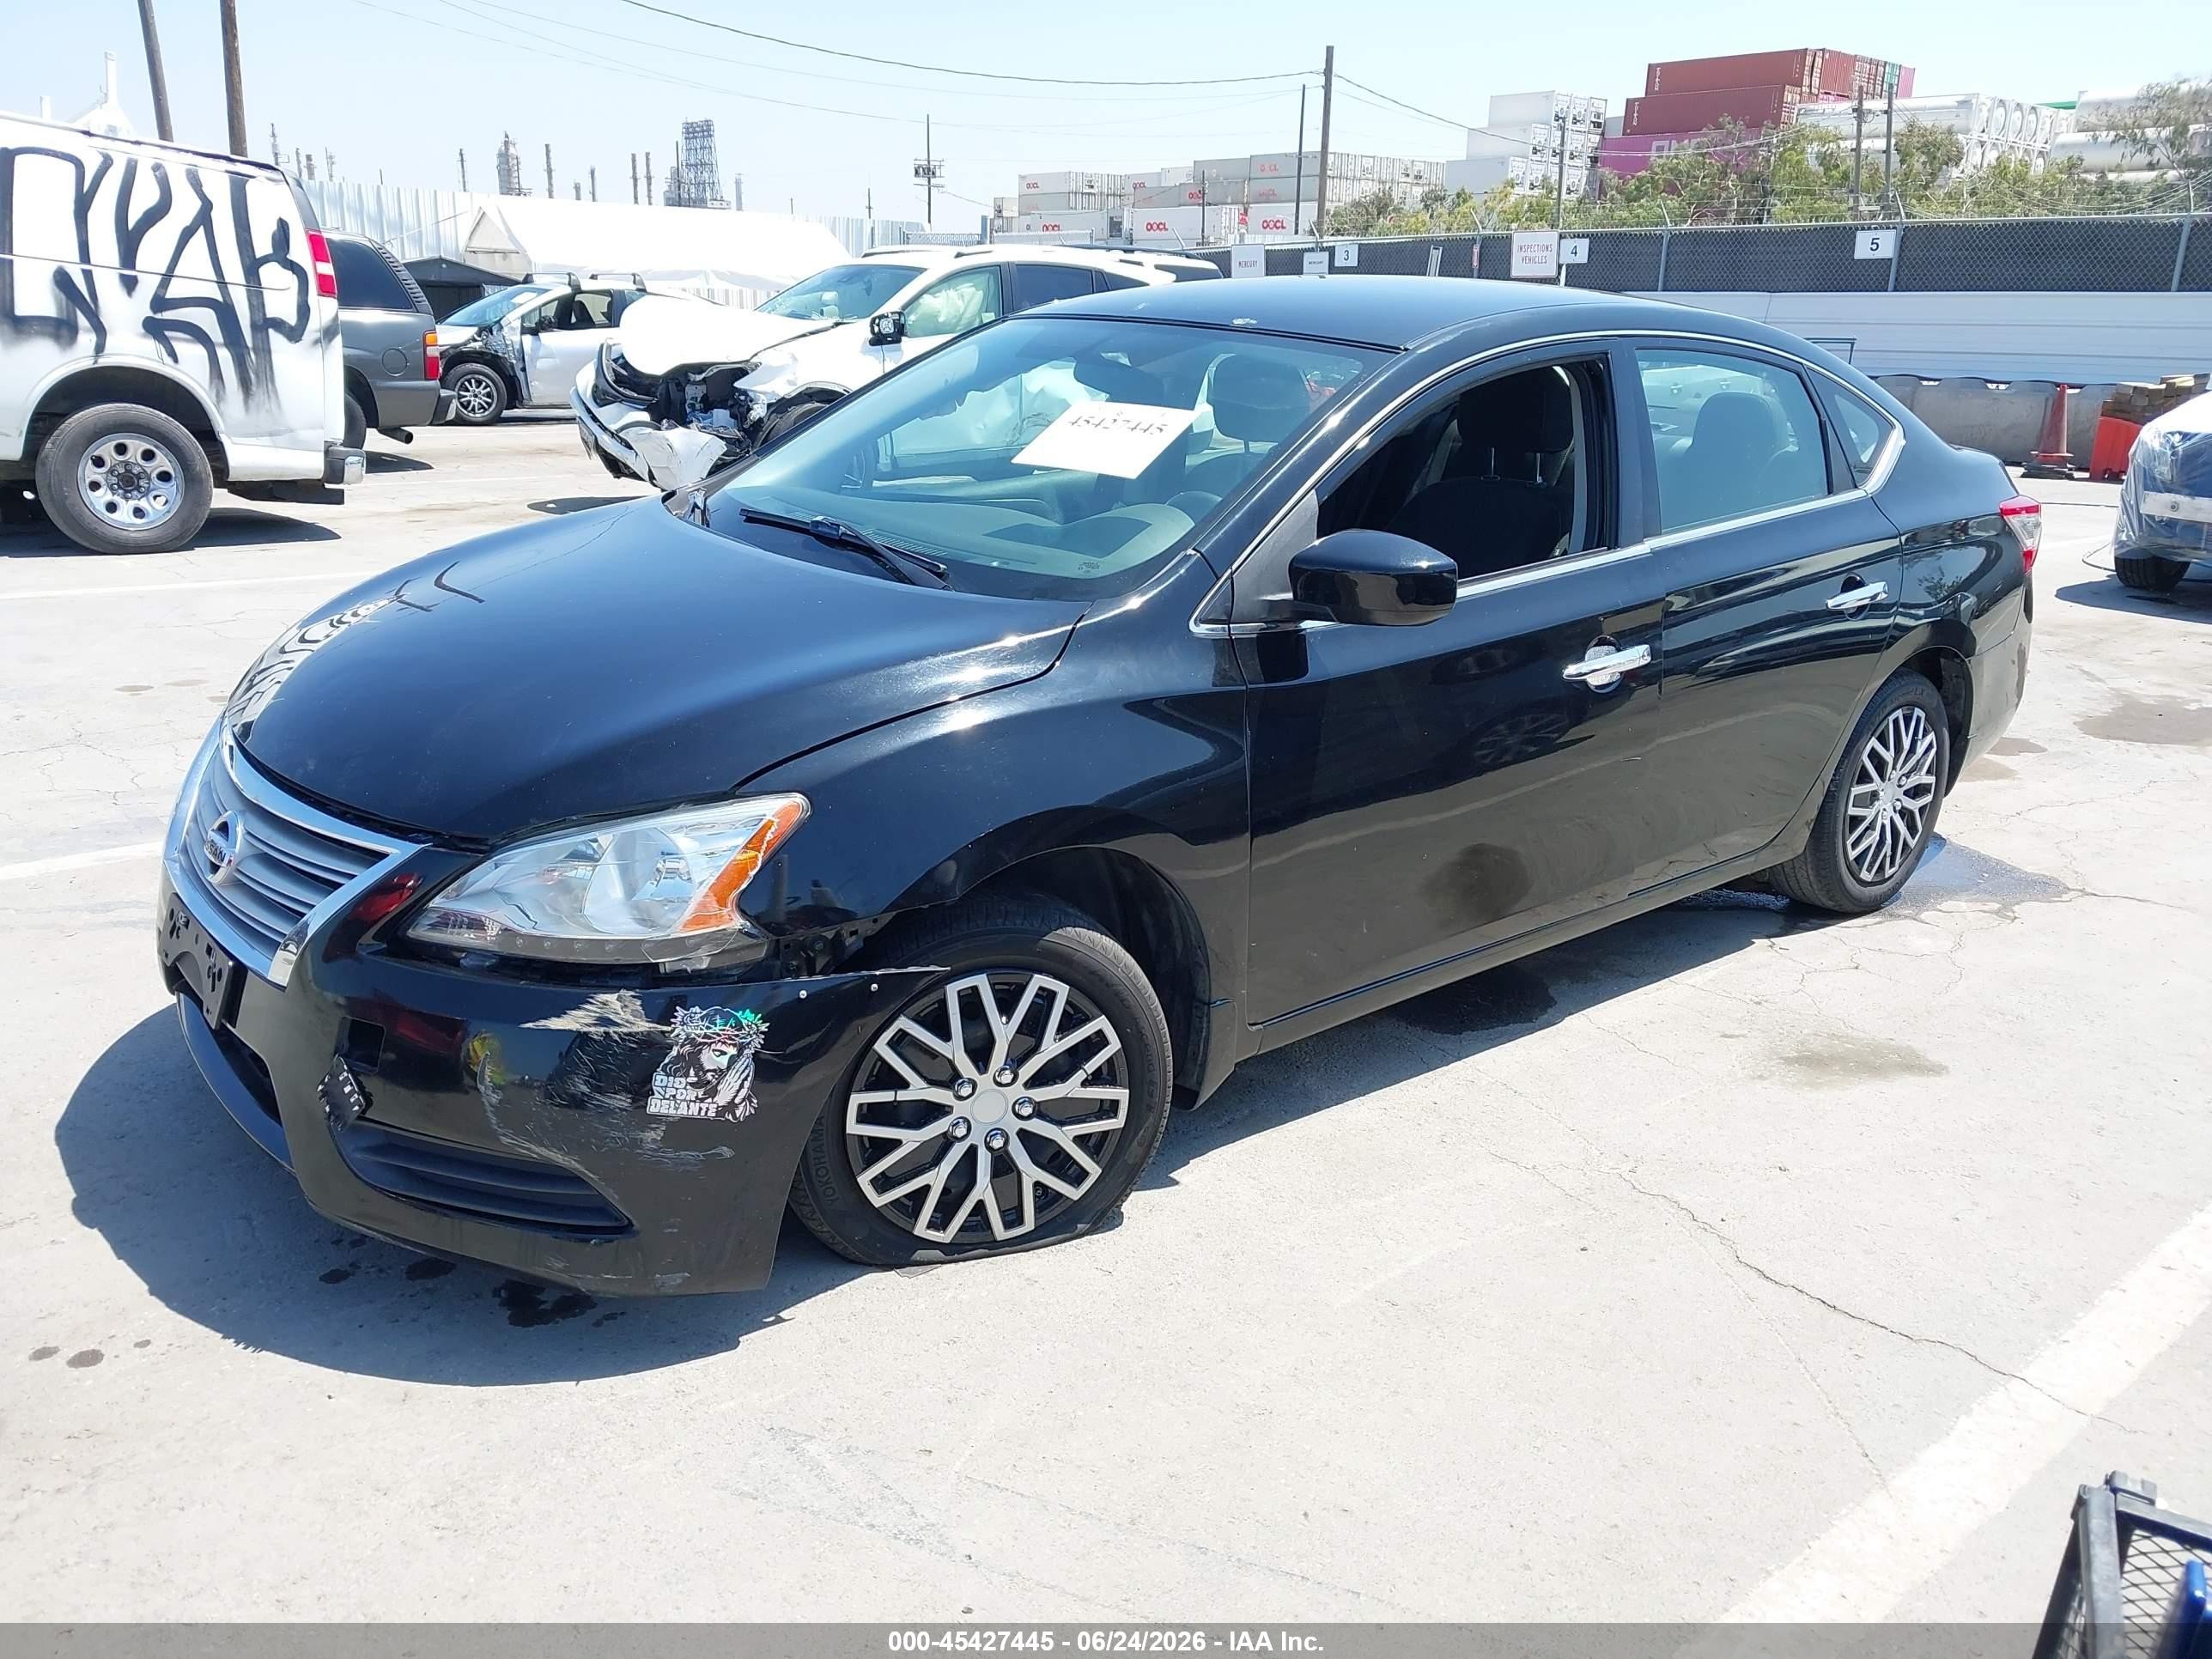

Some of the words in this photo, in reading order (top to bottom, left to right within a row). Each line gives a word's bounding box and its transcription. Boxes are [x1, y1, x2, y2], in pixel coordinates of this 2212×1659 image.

[1146, 222, 1168, 232] OOCL
[1261, 220, 1285, 229] OOCL
[1517, 244, 1553, 252] INSPECTIONS
[1869, 238, 1880, 252] 5
[1344, 250, 1349, 261] 3
[1571, 246, 1577, 257] 4
[1238, 260, 1258, 269] MERCURY
[649, 1099, 717, 1116] DELANTE
